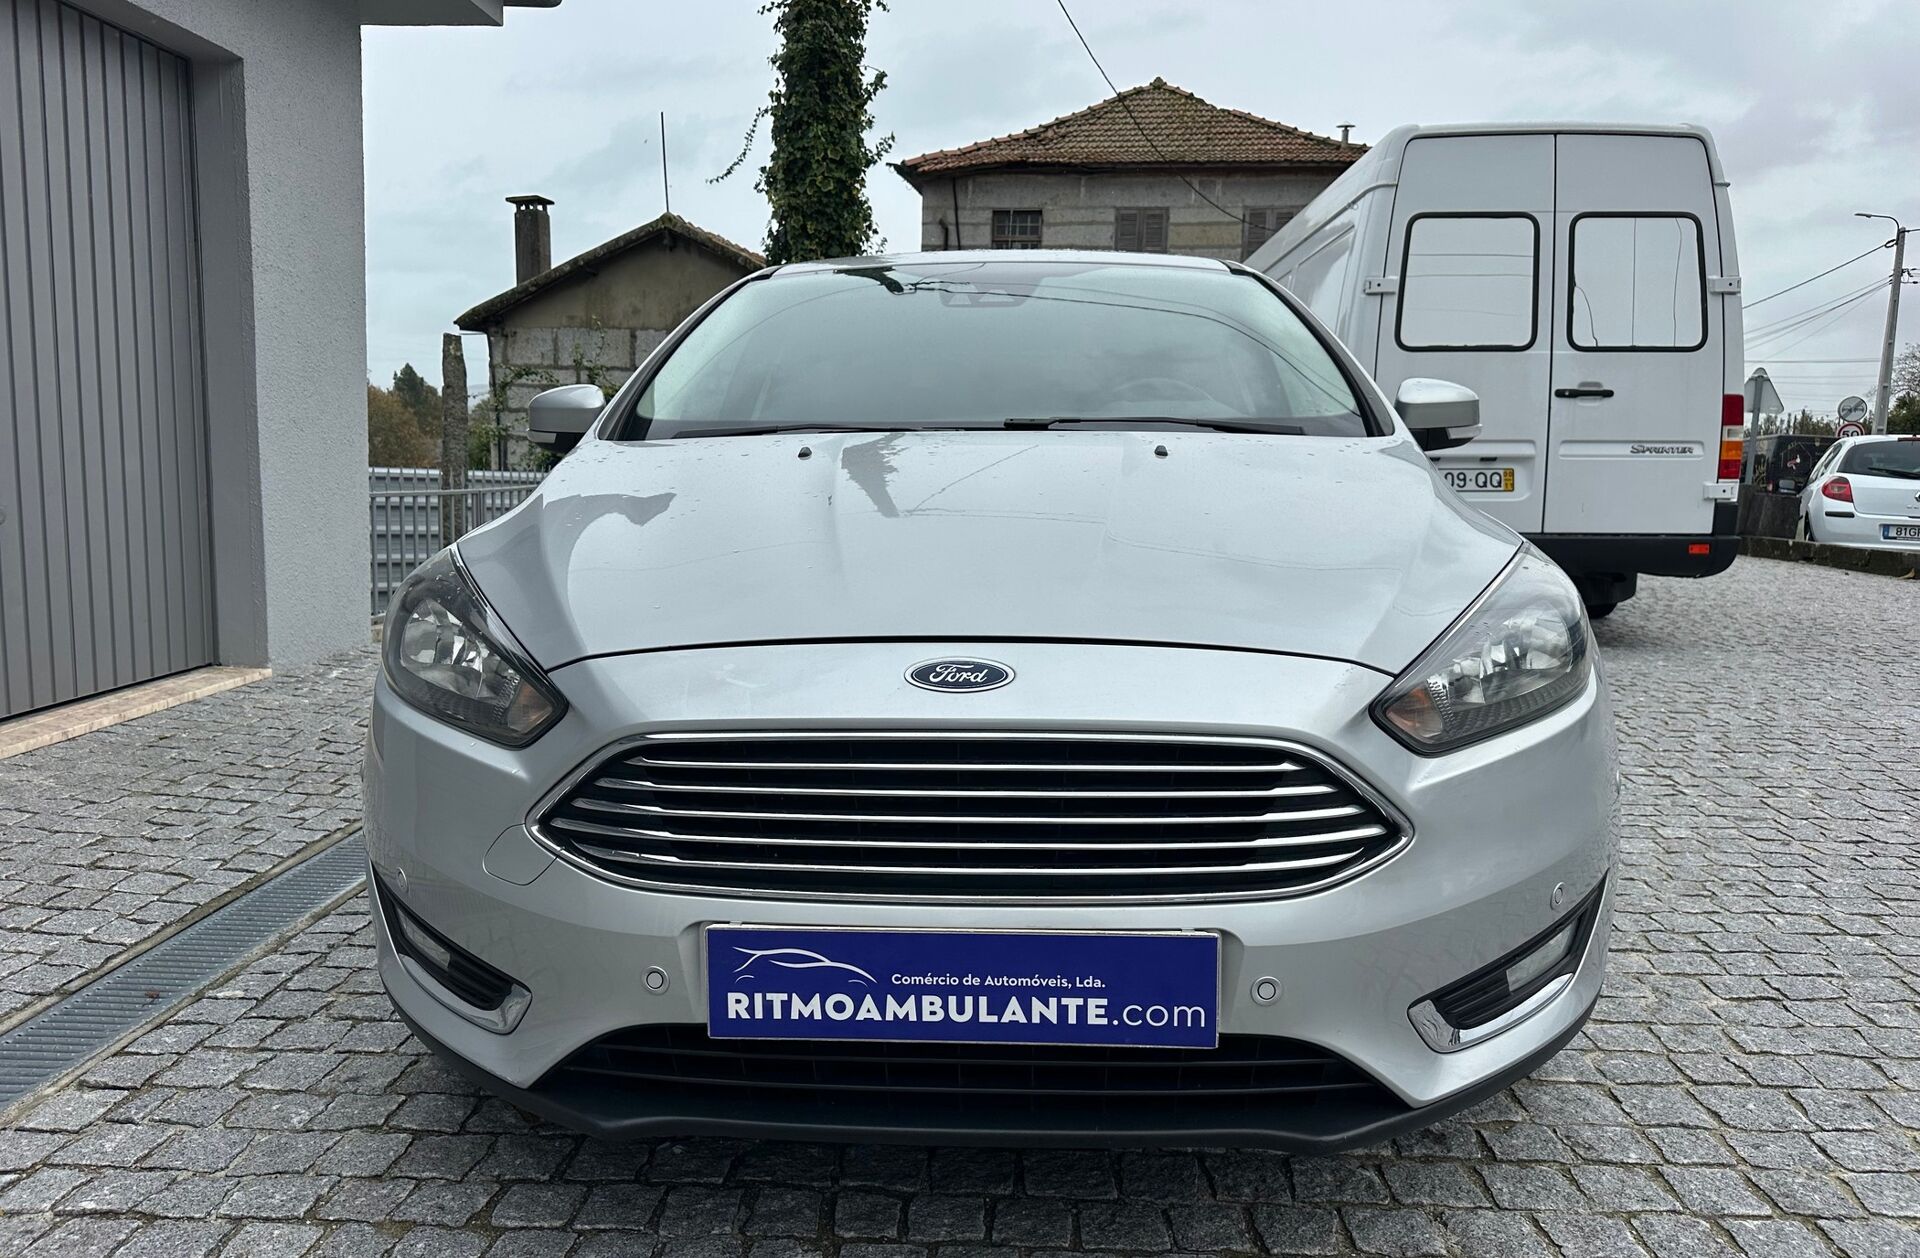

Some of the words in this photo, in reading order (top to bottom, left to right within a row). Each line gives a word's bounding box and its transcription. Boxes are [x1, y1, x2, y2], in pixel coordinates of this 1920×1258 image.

[929, 663, 989, 683] Ford
[891, 973, 959, 985] Comércio
[962, 974, 981, 986] de
[984, 974, 1072, 989] Automóveis,
[1075, 976, 1106, 988] Lda.
[727, 992, 1206, 1028] RITMOAMBULANTE.com
